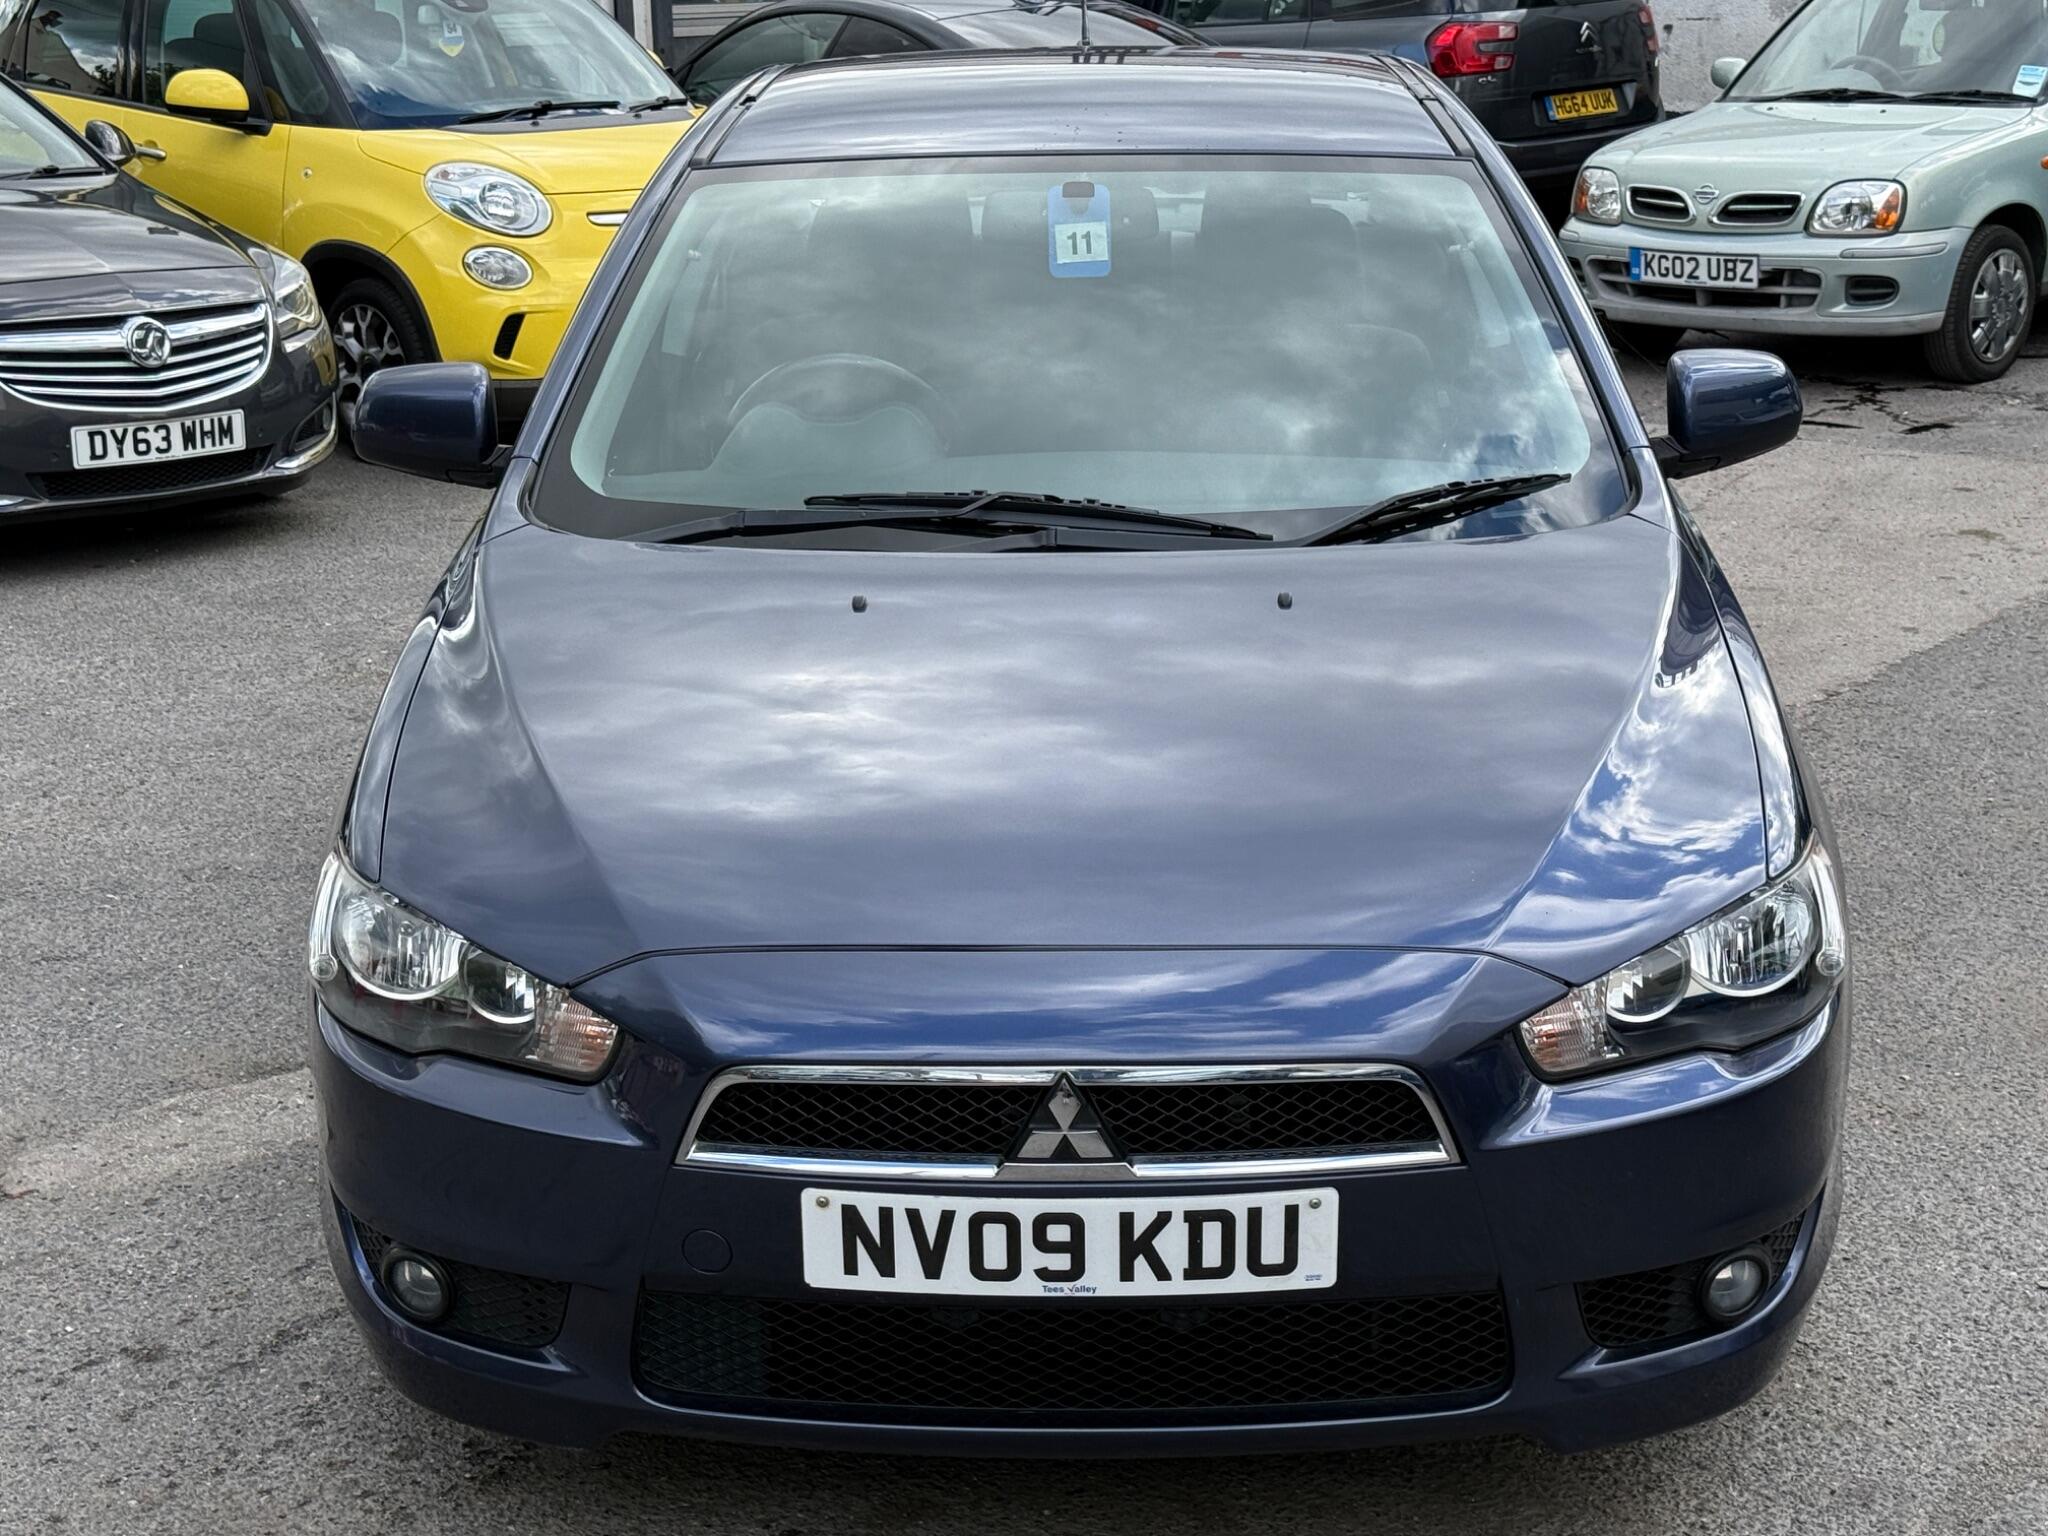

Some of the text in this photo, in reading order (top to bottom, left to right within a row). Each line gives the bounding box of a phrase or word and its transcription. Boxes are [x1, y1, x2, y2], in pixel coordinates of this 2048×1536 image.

[1553, 91, 1615, 116] HG64 UUK
[1066, 230, 1092, 255] 11
[1643, 252, 1754, 283] KG02 UBZ
[87, 415, 235, 461] DY63 WHM
[841, 1203, 1300, 1283] NV09 KDU
[1042, 1284, 1097, 1294] Tees Valley
